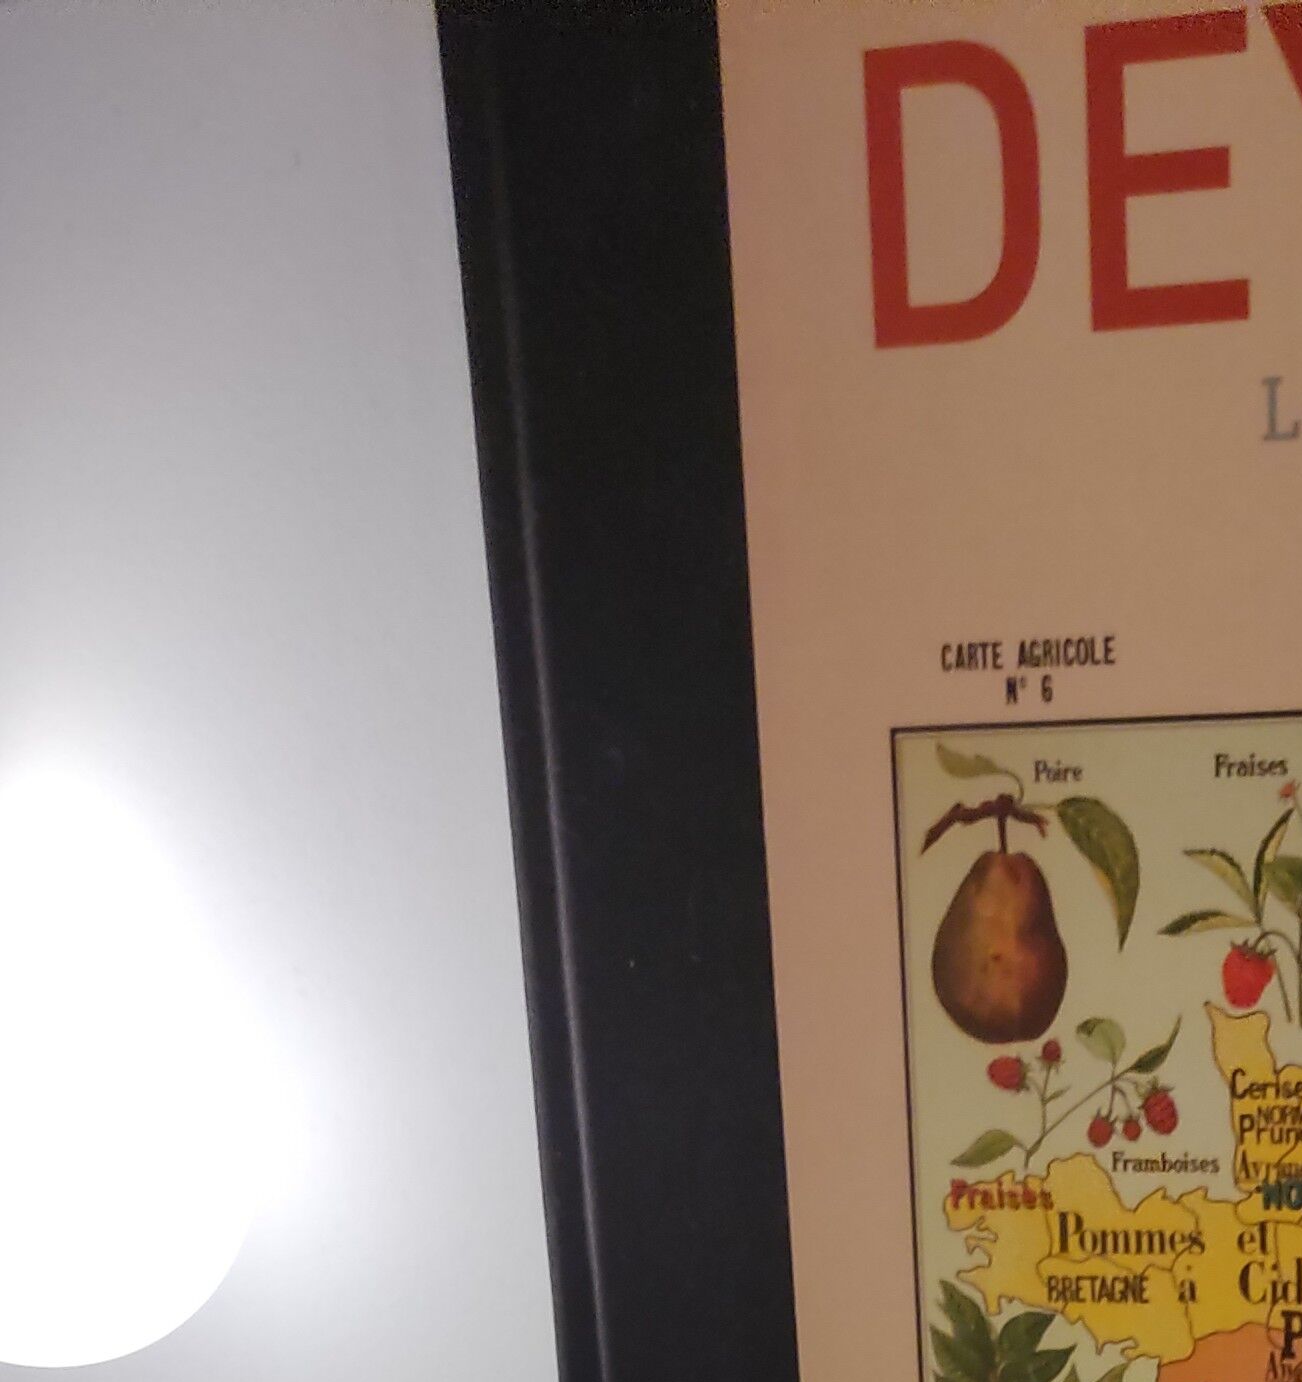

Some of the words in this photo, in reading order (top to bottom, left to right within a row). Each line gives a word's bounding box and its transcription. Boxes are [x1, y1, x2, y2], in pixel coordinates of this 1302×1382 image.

[940, 640, 1003, 674] CARTE
[1016, 635, 1117, 669] AGRICOLE
[1041, 675, 1053, 702] 6
[1033, 759, 1084, 785] Poire
[1213, 753, 1289, 779] Fraises
[1112, 1151, 1221, 1175] Framboises
[950, 1178, 1054, 1211] Fraises
[1057, 1212, 1206, 1256] Pommes
[1237, 1220, 1270, 1256] et
[1046, 1274, 1151, 1305] BRETAGNE
